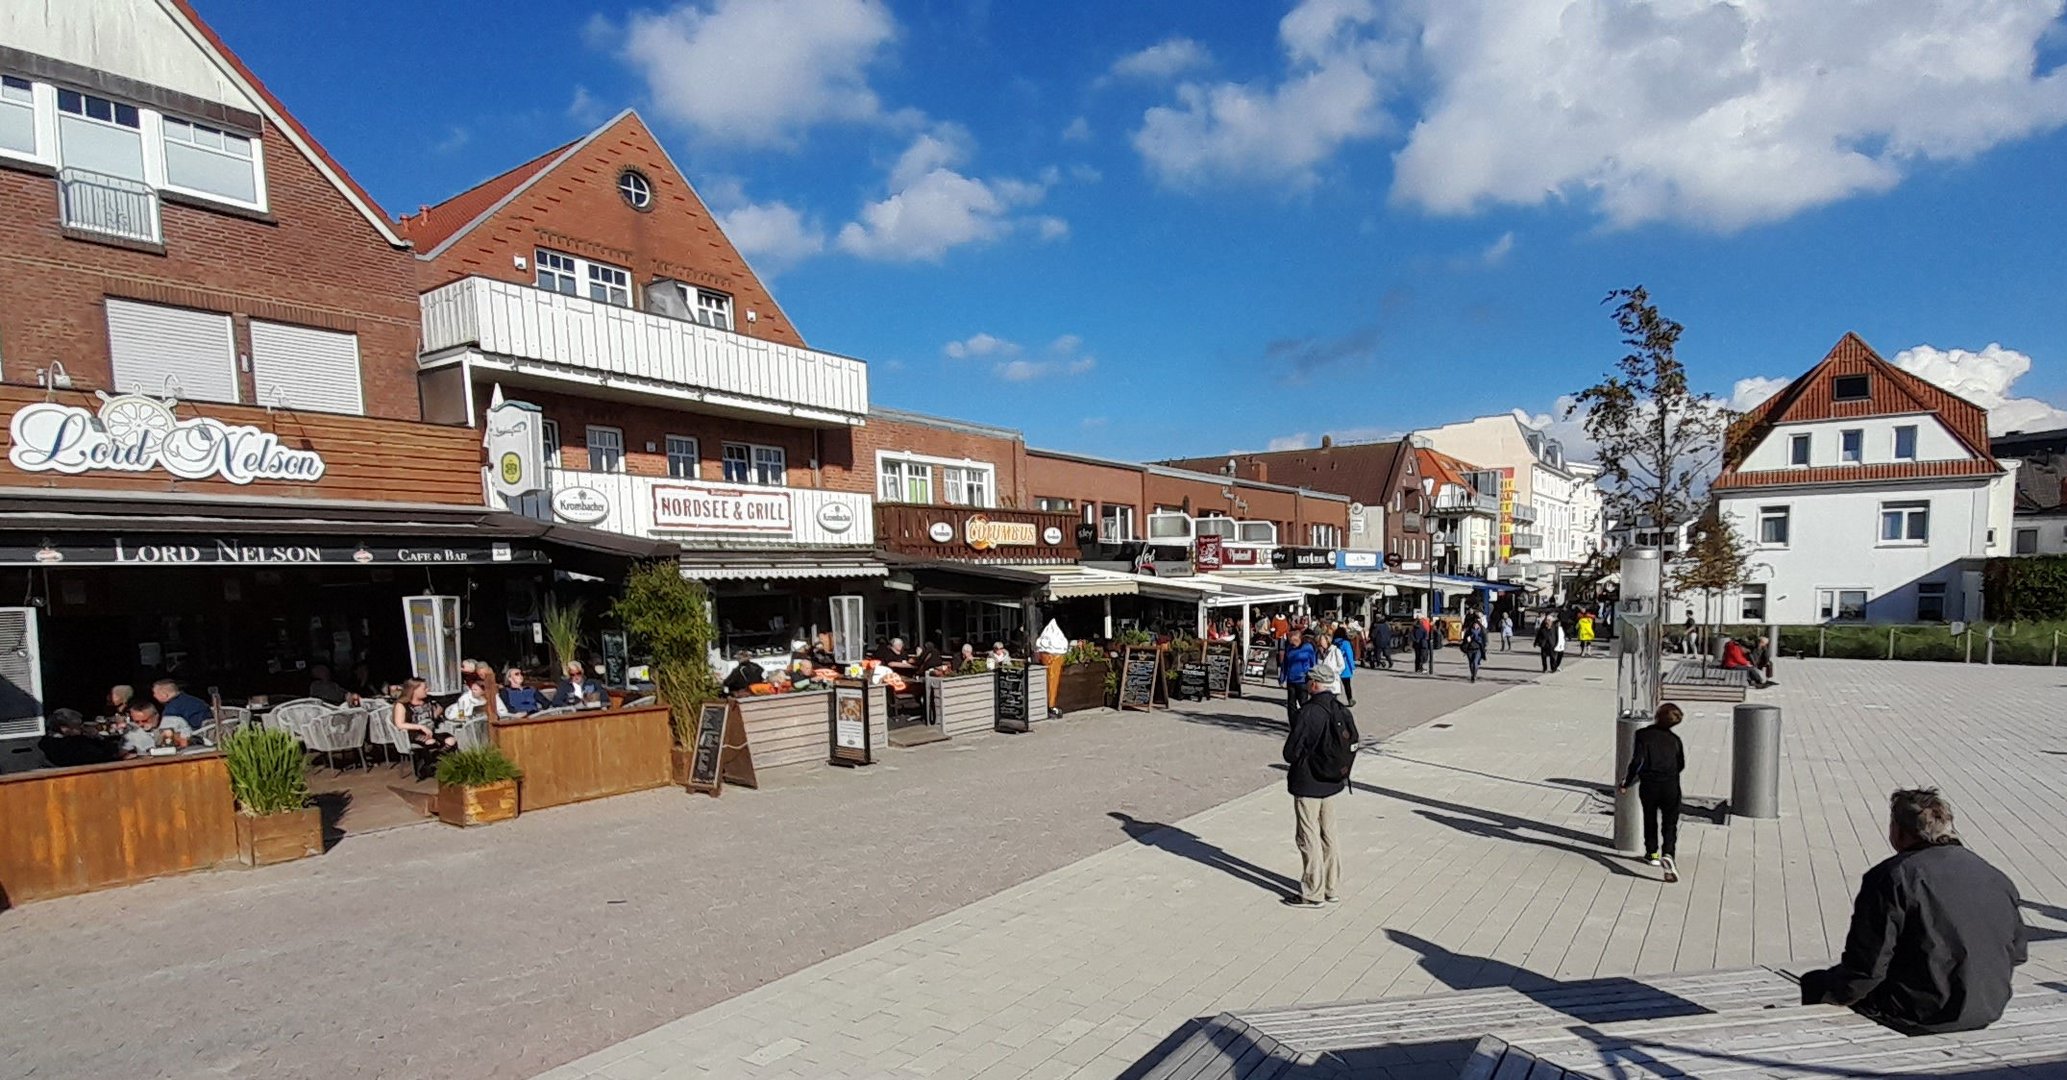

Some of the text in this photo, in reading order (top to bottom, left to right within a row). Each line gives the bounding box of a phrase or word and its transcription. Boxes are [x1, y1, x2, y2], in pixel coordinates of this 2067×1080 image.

[20, 409, 320, 477] Lord Nelson
[661, 498, 785, 521] NORDSEE & GRILL
[968, 521, 1035, 541] COLUMBUS
[114, 538, 321, 562] LORD NELSON
[445, 549, 467, 561] BAR
